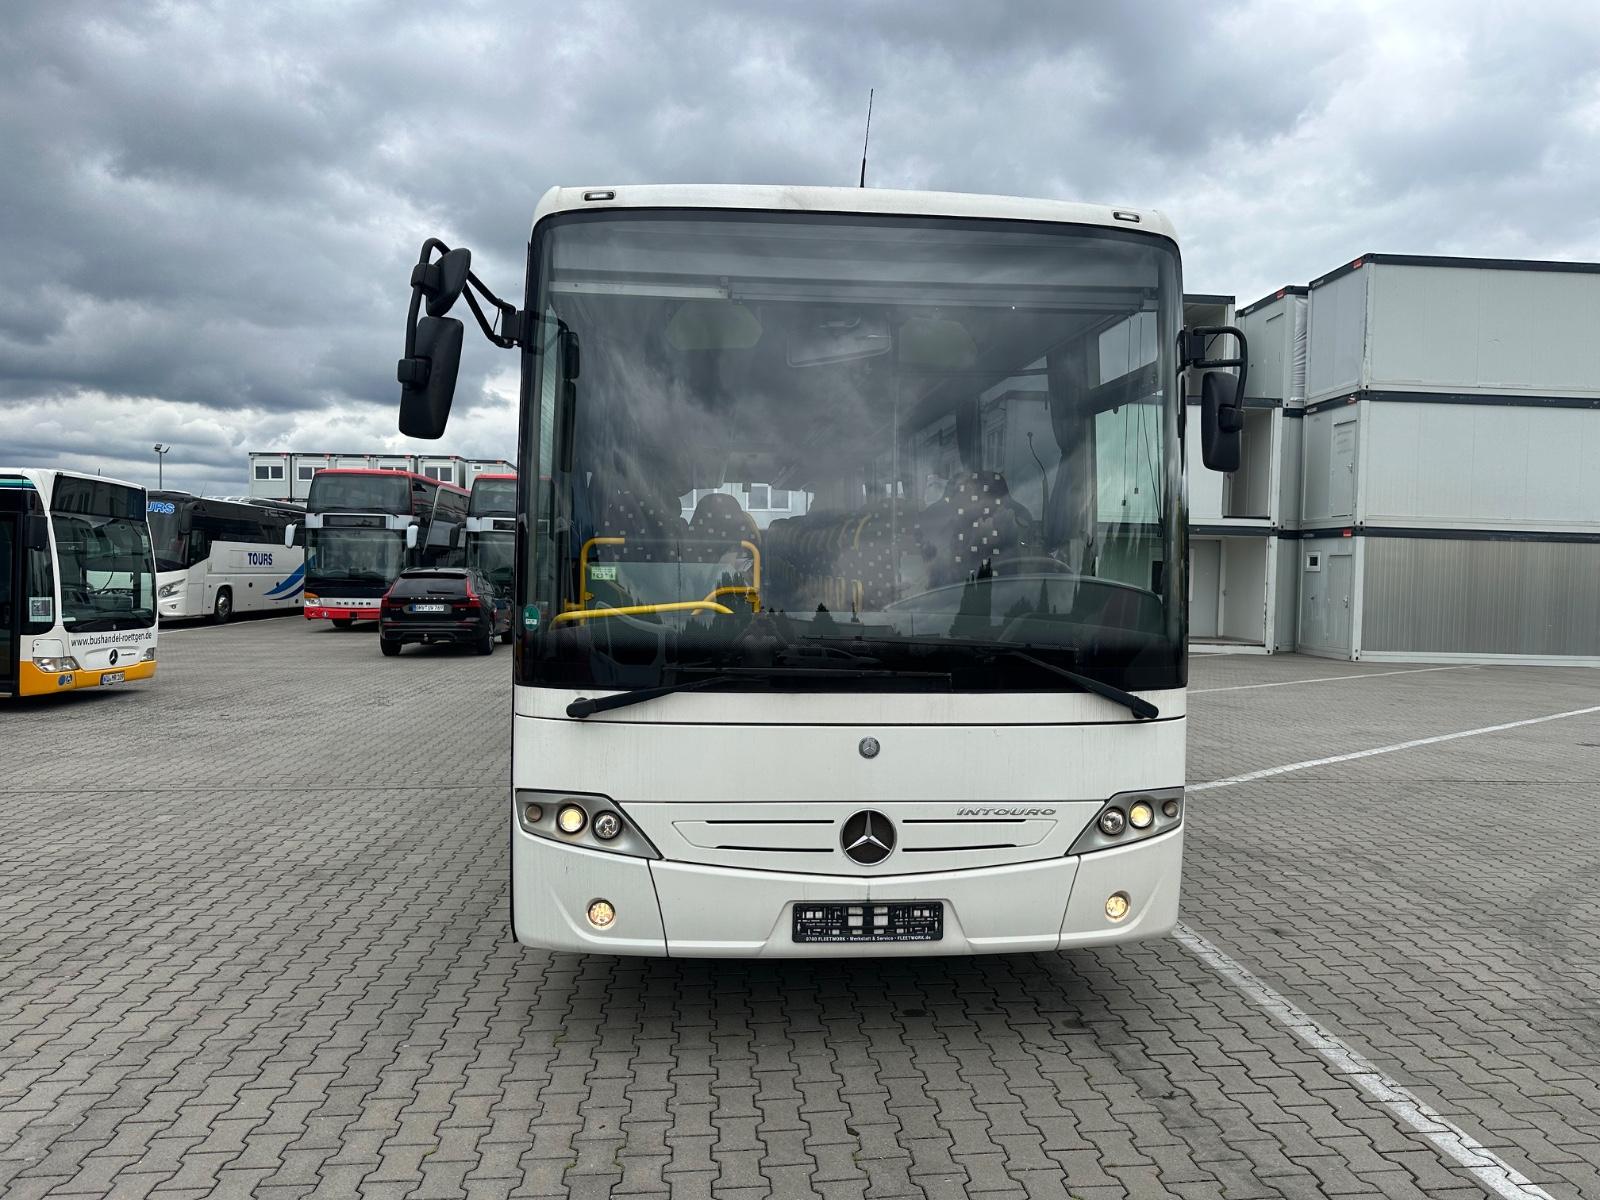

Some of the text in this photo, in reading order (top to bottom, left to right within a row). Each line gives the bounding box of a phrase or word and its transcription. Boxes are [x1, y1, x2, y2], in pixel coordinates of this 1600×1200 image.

[248, 552, 273, 566] TOURS
[71, 631, 152, 647] www.bushandel-roettgen.de
[957, 808, 1056, 816] INTOURO
